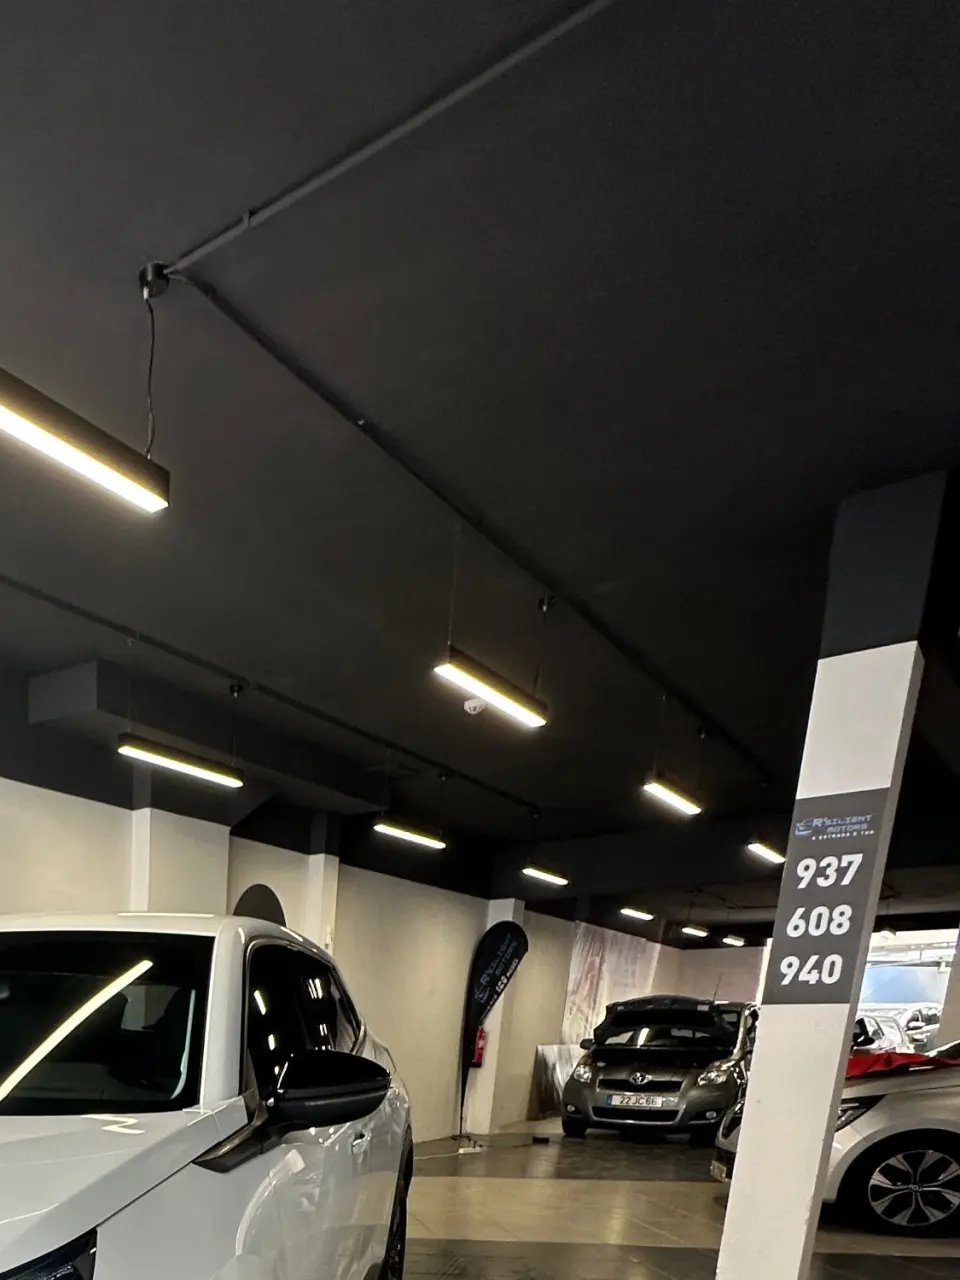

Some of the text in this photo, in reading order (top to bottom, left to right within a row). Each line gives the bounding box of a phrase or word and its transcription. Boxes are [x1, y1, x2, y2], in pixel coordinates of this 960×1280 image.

[796, 853, 863, 889] 937
[786, 904, 852, 938] 608
[780, 953, 843, 986] 940
